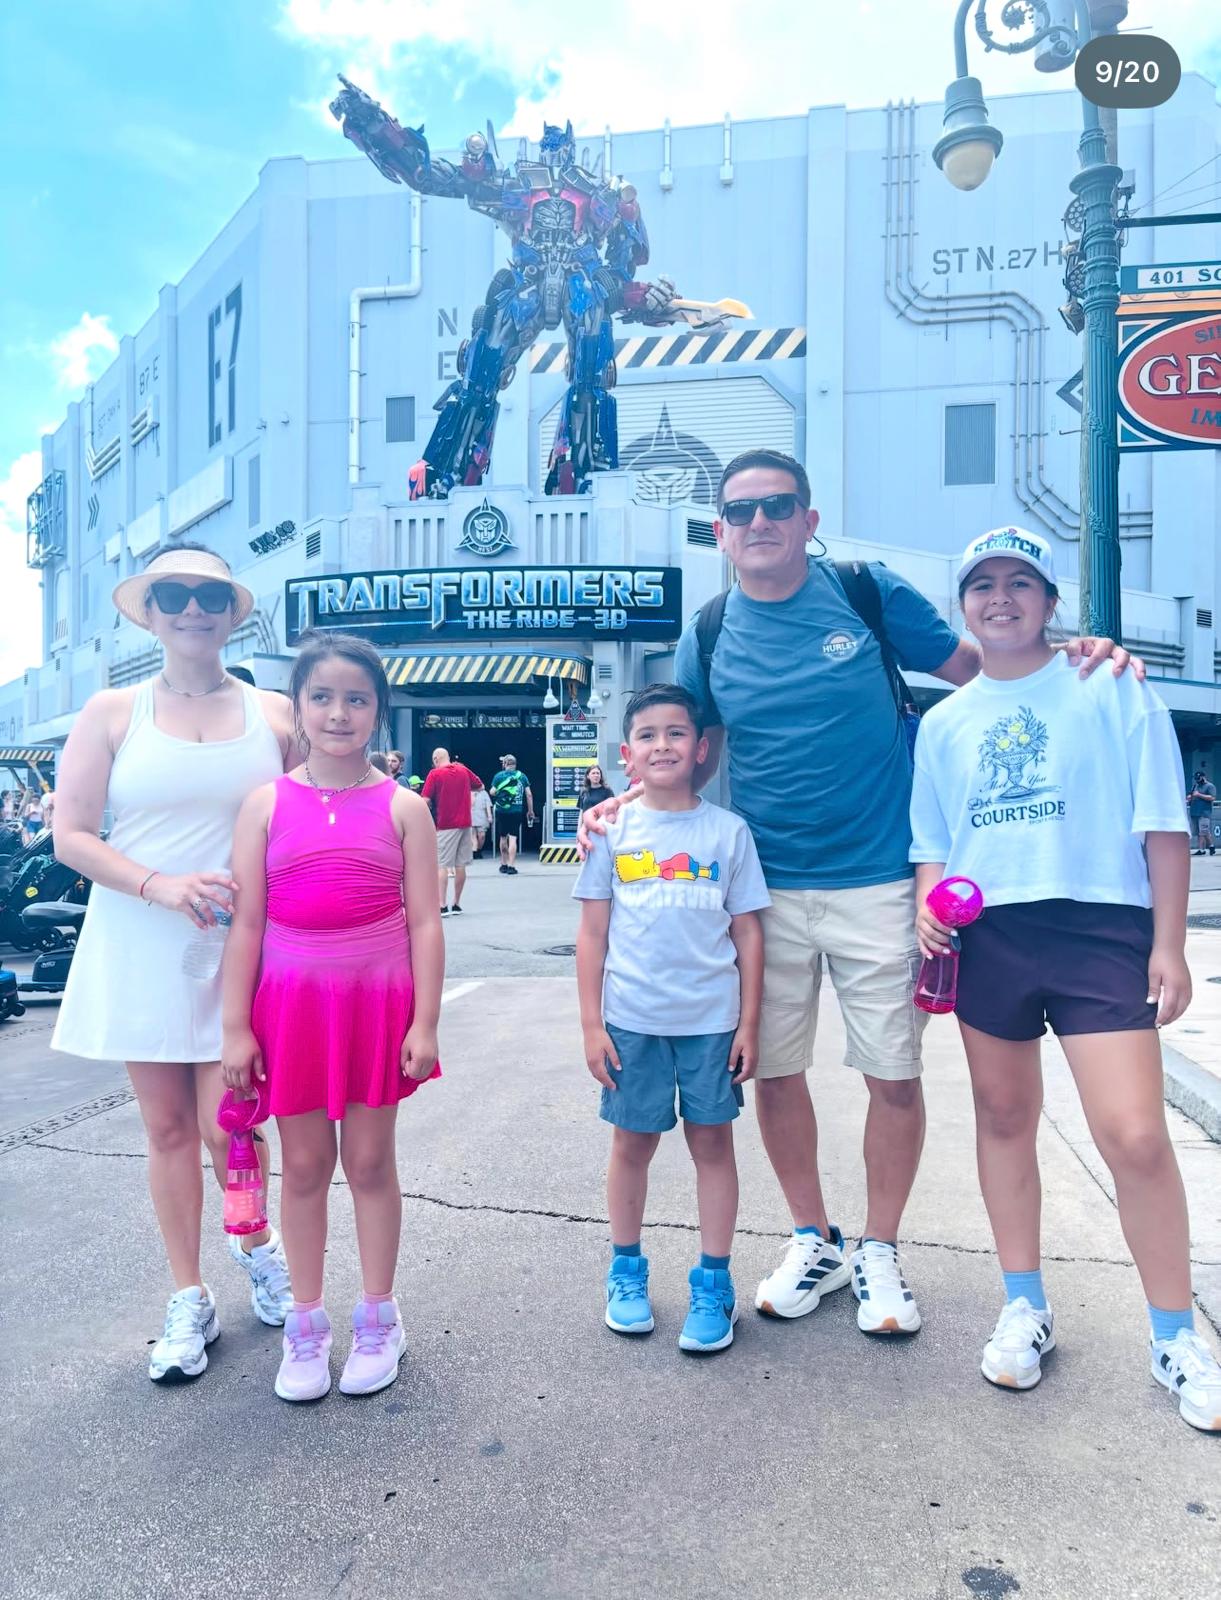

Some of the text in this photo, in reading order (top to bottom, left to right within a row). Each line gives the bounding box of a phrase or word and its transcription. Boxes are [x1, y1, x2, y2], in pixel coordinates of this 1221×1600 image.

[1149, 270, 1184, 285] 401
[289, 570, 665, 634] TRANSFORMERS
[463, 609, 512, 630] THE
[822, 640, 857, 653] HURLEY
[488, 715, 502, 723] SINGLE
[1027, 772, 1047, 789] You
[971, 800, 1066, 828] COURTSIDE
[617, 882, 722, 911] WHATEVER
